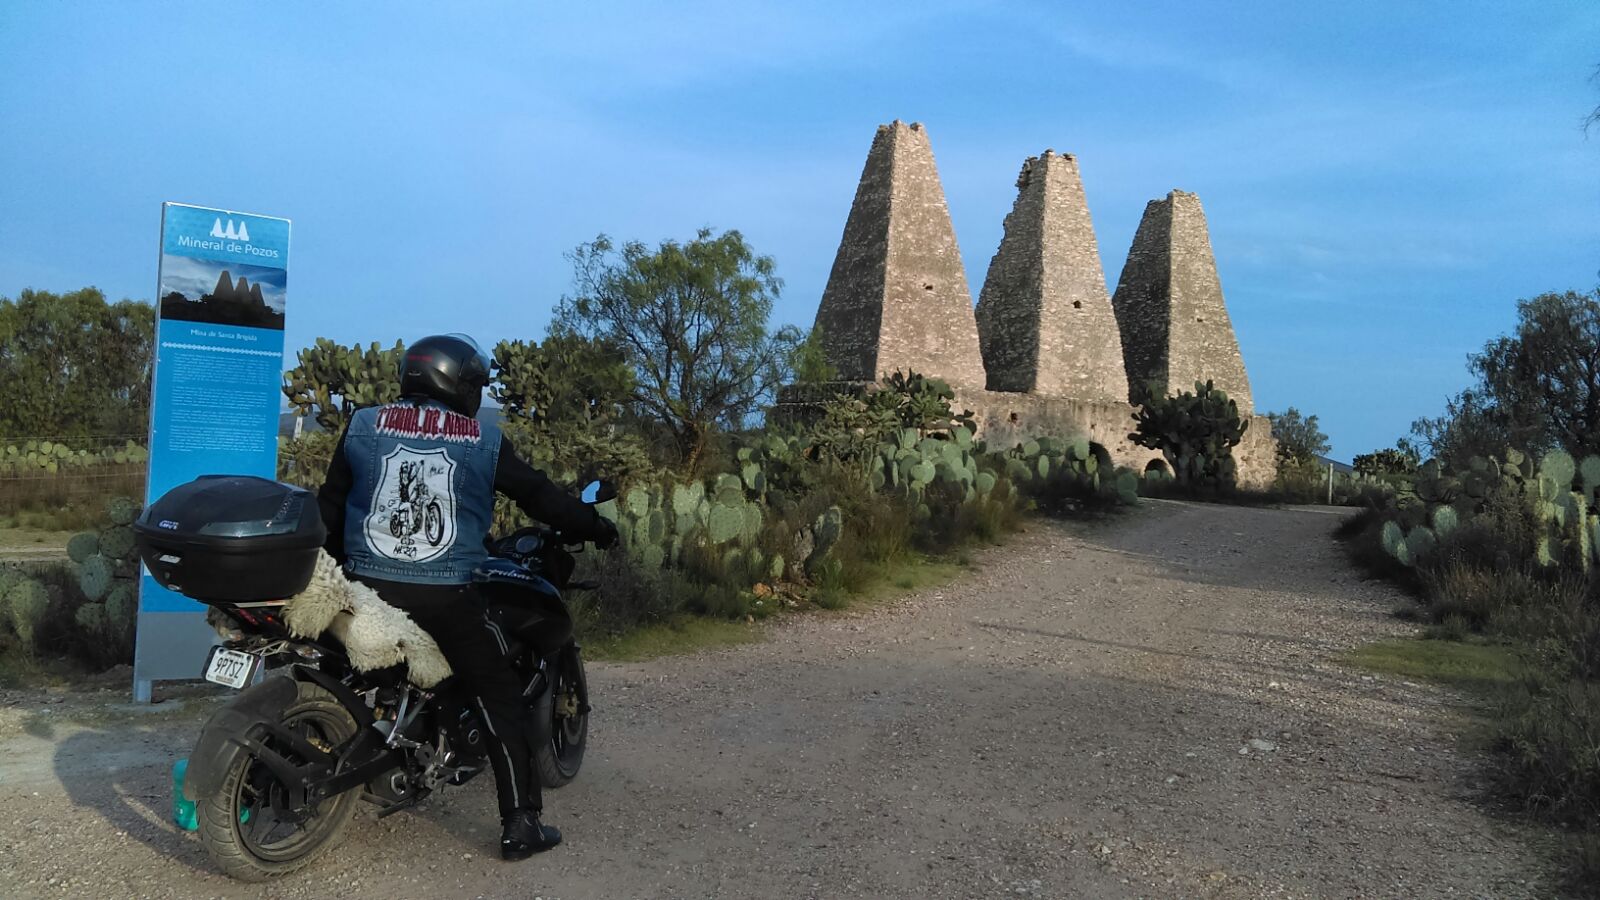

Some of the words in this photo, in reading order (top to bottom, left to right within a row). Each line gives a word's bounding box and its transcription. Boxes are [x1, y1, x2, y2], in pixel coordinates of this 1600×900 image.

[178, 235, 224, 251] Mineral
[226, 241, 243, 253] de
[244, 243, 279, 258] Pozos
[190, 329, 207, 337] Mina
[217, 331, 235, 339] Santa
